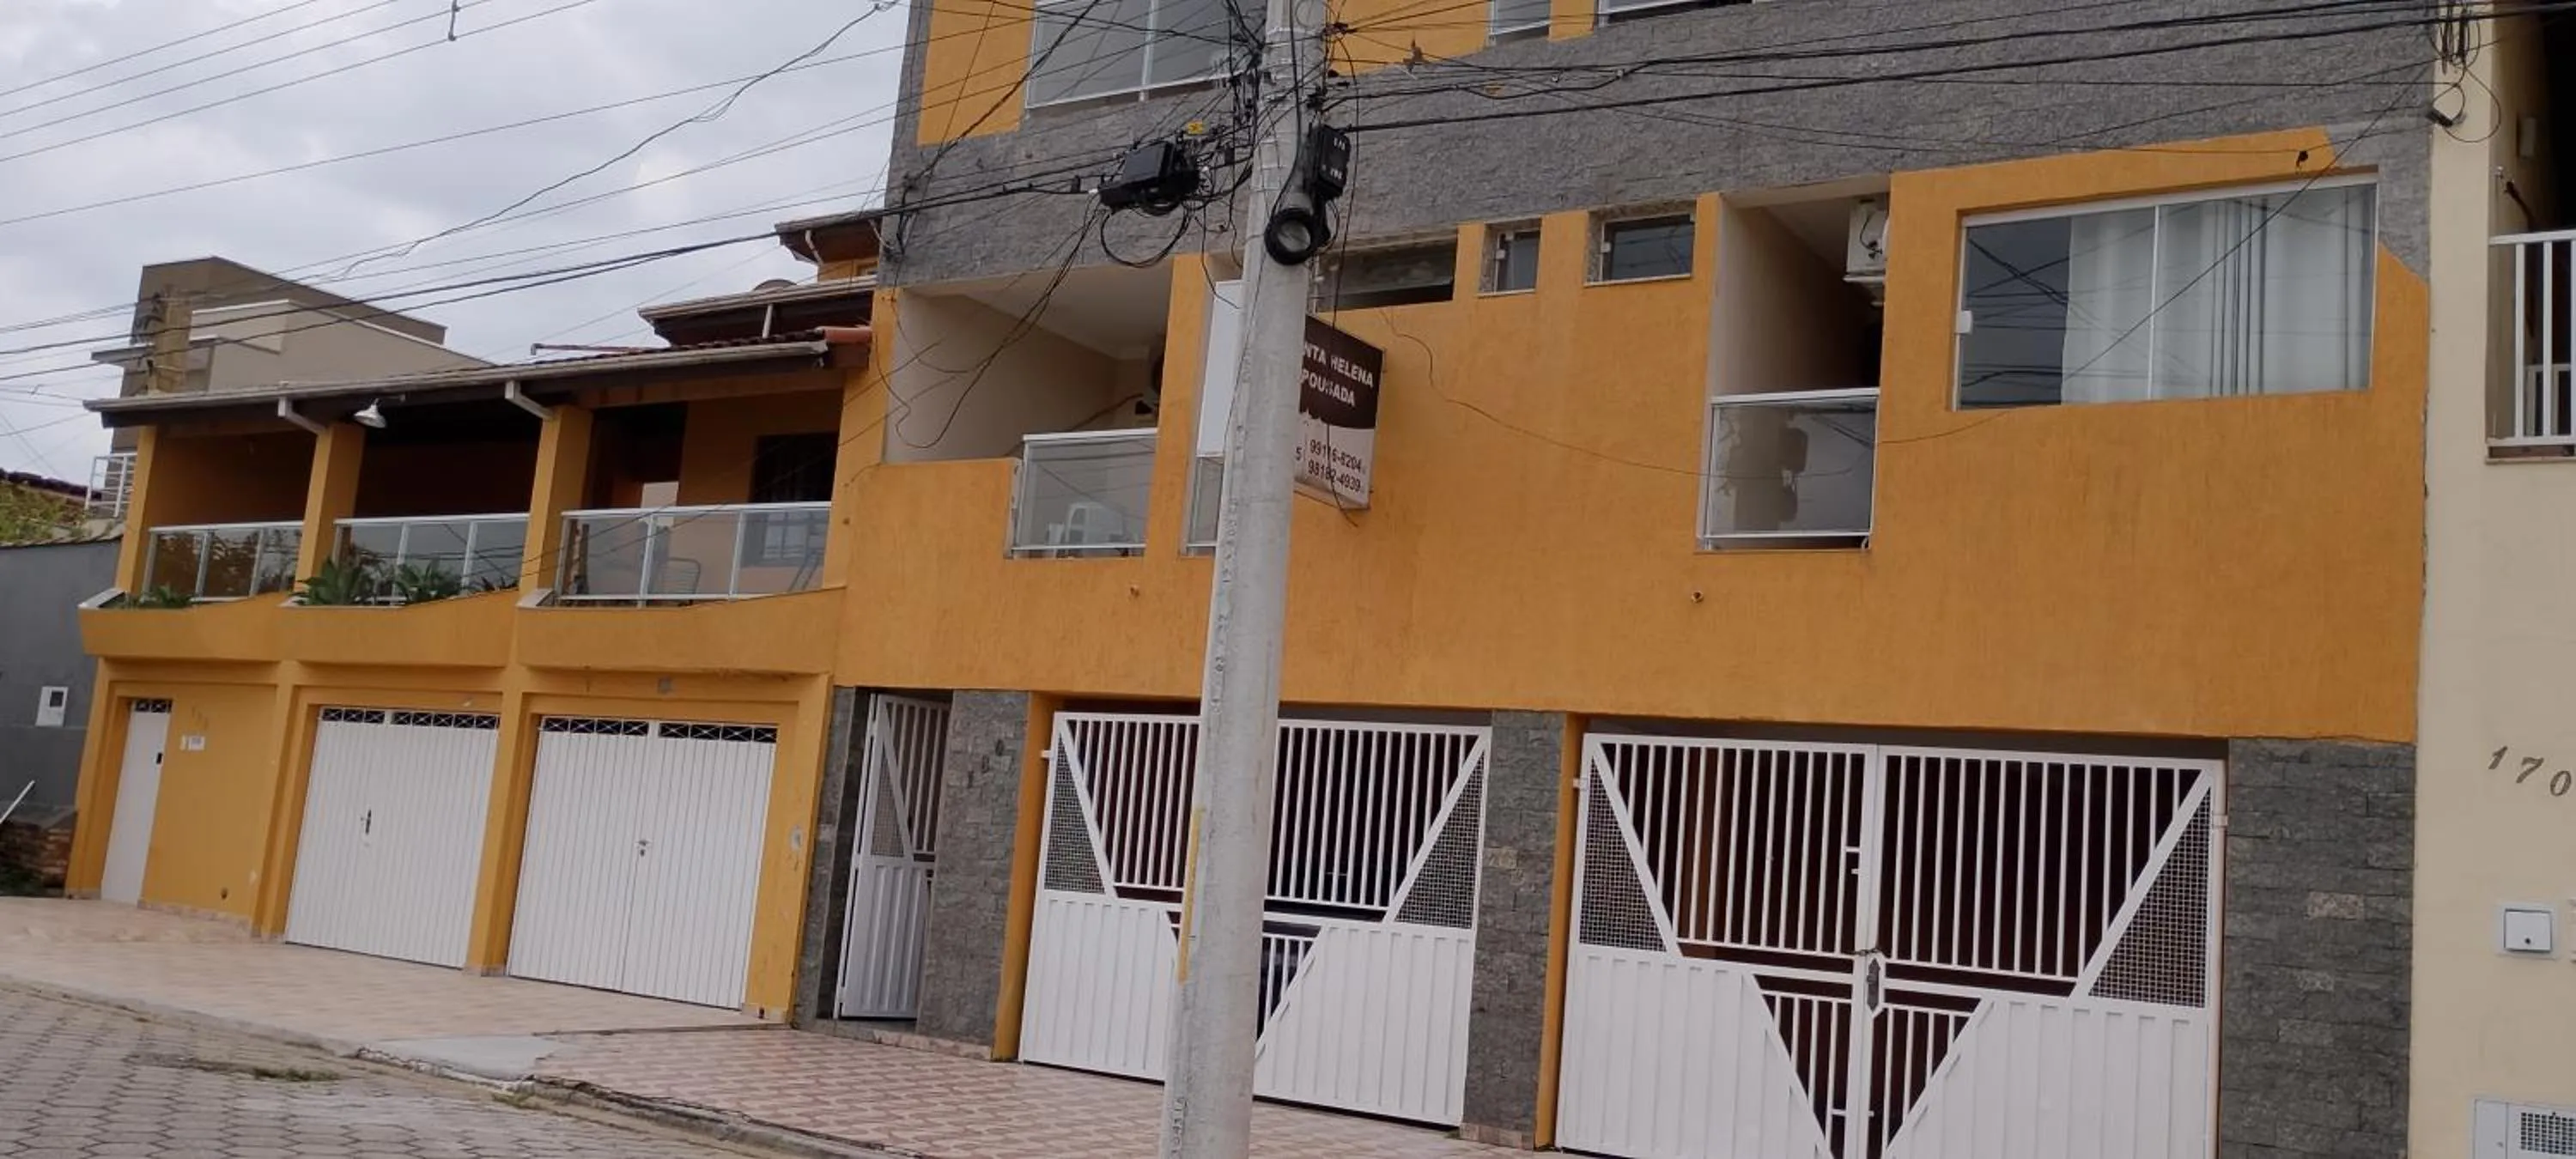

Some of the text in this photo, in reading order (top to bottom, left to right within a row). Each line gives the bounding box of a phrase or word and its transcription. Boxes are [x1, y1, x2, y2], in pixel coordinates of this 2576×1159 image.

[1304, 341, 1374, 388] NTA HELENA
[2488, 745, 2573, 797] 170
